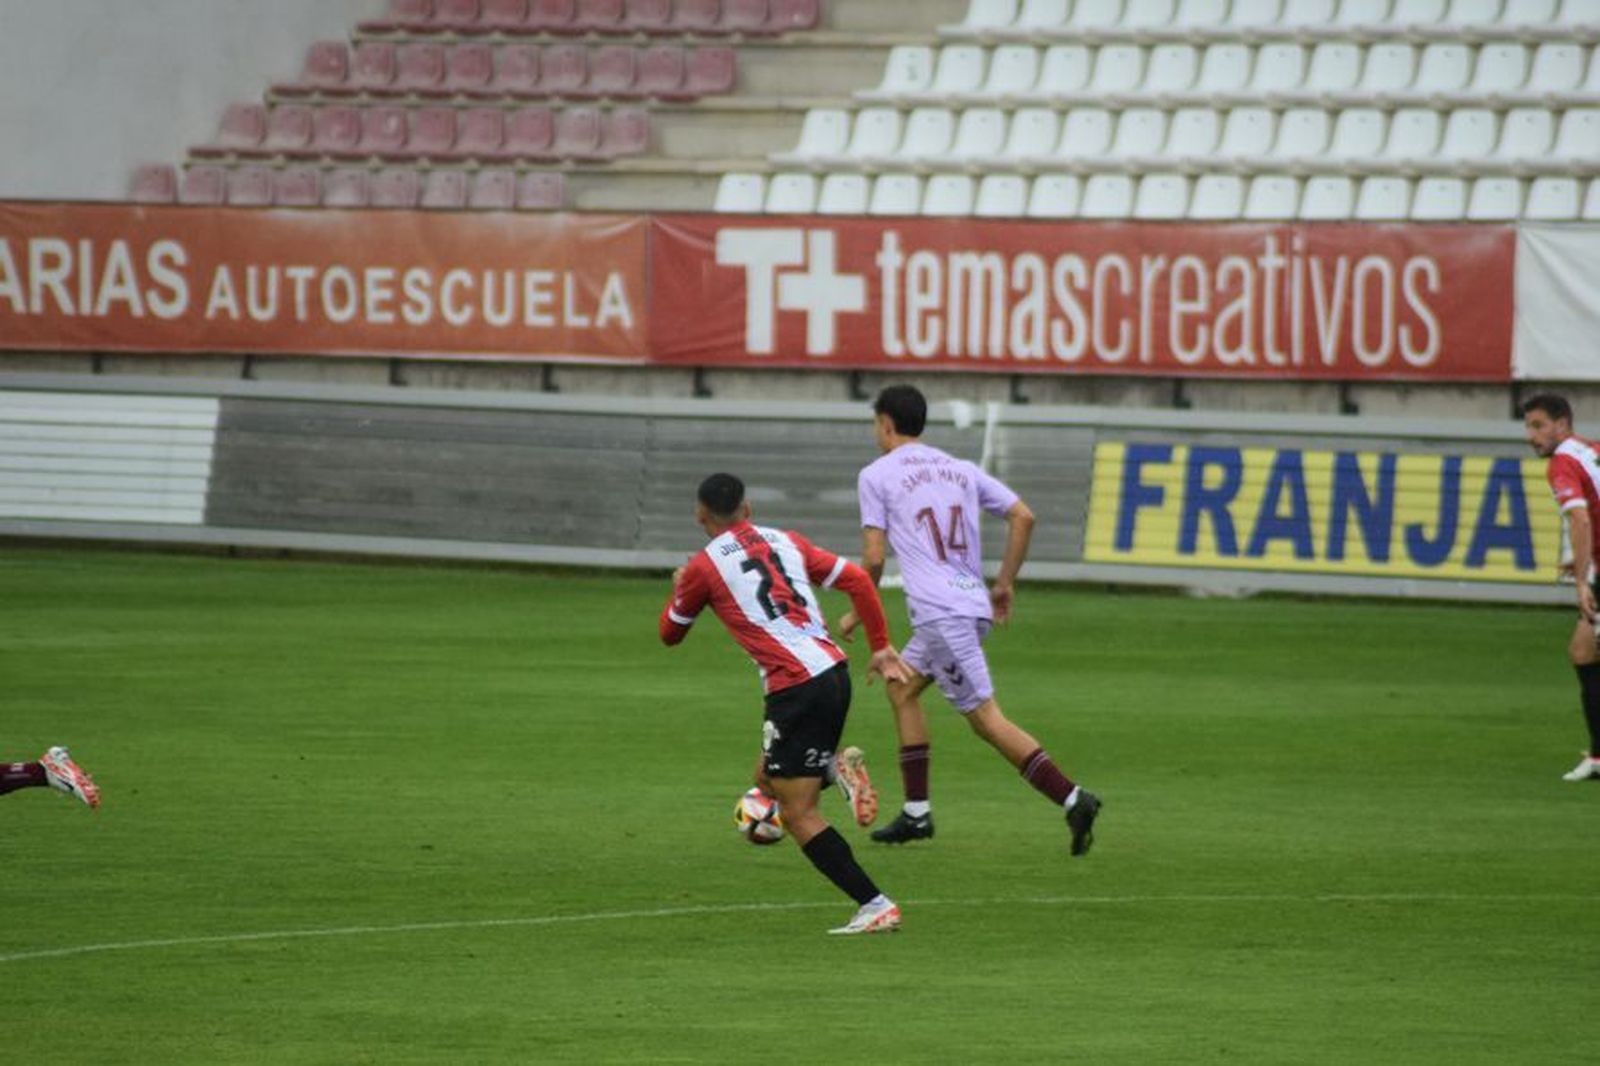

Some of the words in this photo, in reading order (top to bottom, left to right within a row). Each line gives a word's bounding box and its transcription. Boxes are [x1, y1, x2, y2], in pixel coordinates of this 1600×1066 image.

[0, 238, 189, 319] ARIAS
[206, 265, 634, 329] AUTOESCUELA
[876, 231, 1442, 367] temascreativos
[914, 504, 969, 564] 14
[1113, 443, 1537, 571] FRANJA
